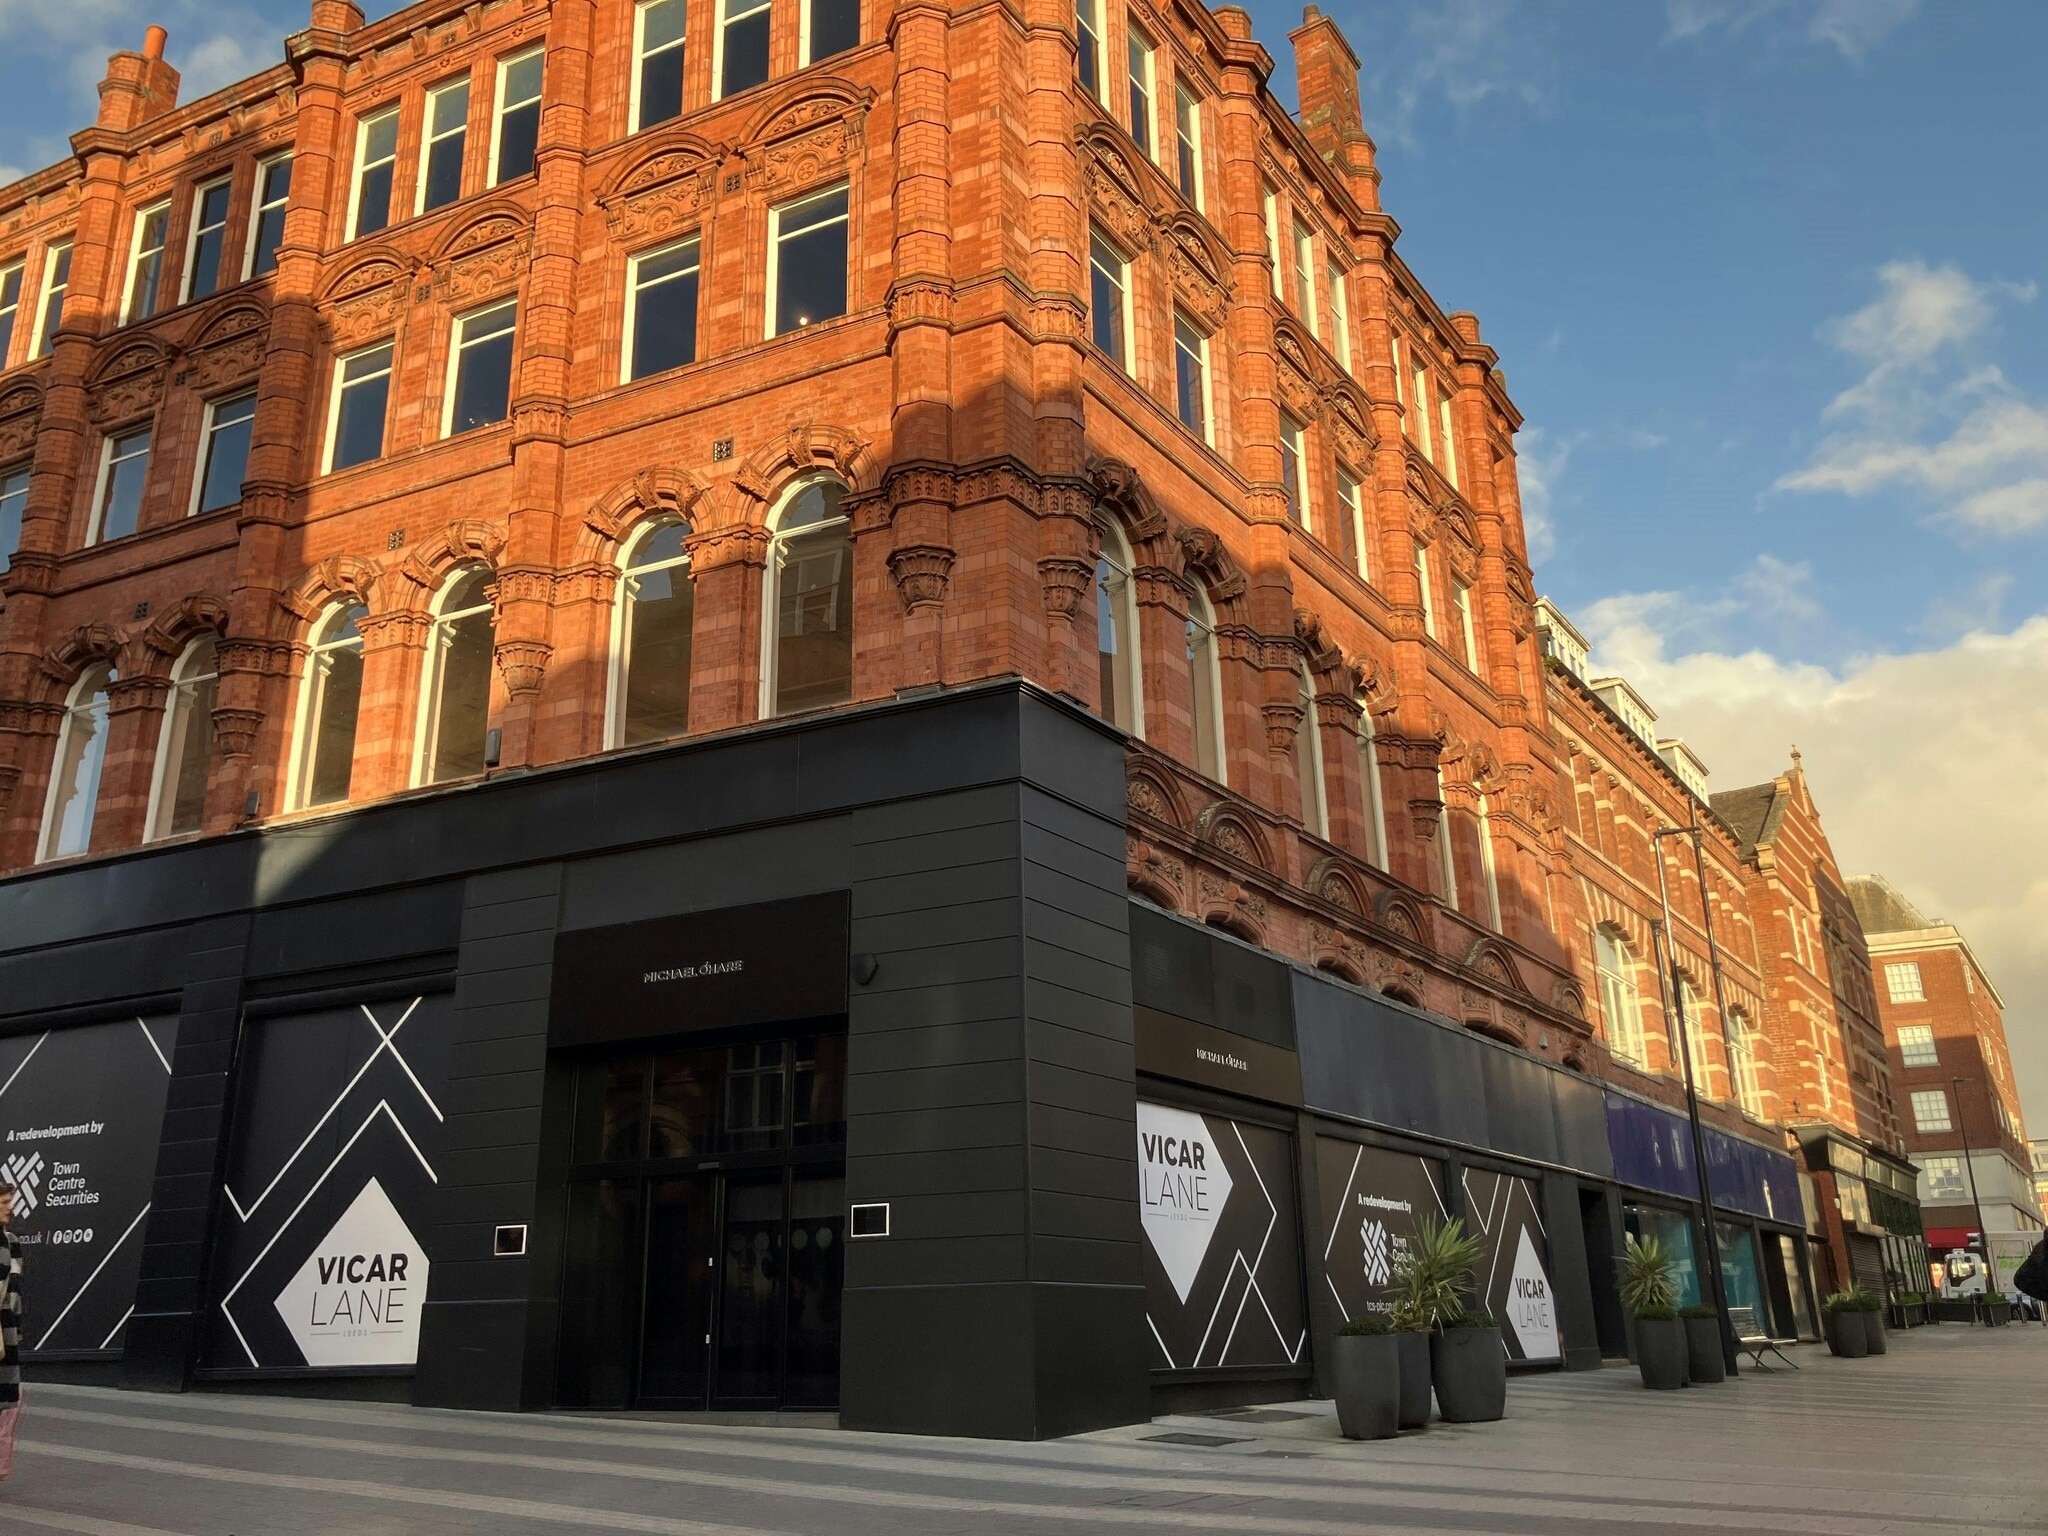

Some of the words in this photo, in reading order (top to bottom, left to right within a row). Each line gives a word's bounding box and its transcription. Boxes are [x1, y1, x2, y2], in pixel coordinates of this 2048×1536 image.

[643, 967, 698, 983] MICHAEL
[6, 1130, 15, 1142] A
[15, 1123, 89, 1140] redevelopment
[90, 1120, 104, 1135] by
[1142, 1132, 1206, 1171] VICAR
[53, 1161, 80, 1175] Town
[48, 1177, 85, 1191] Centre
[1144, 1168, 1209, 1211] LANE
[45, 1190, 100, 1207] Securities
[1363, 1194, 1404, 1211] redevelopment
[1404, 1200, 1411, 1214] by
[318, 1253, 409, 1285] VICAR
[1515, 1277, 1545, 1299] VICAR
[311, 1287, 407, 1326] LANE
[1517, 1302, 1549, 1328] LANE
